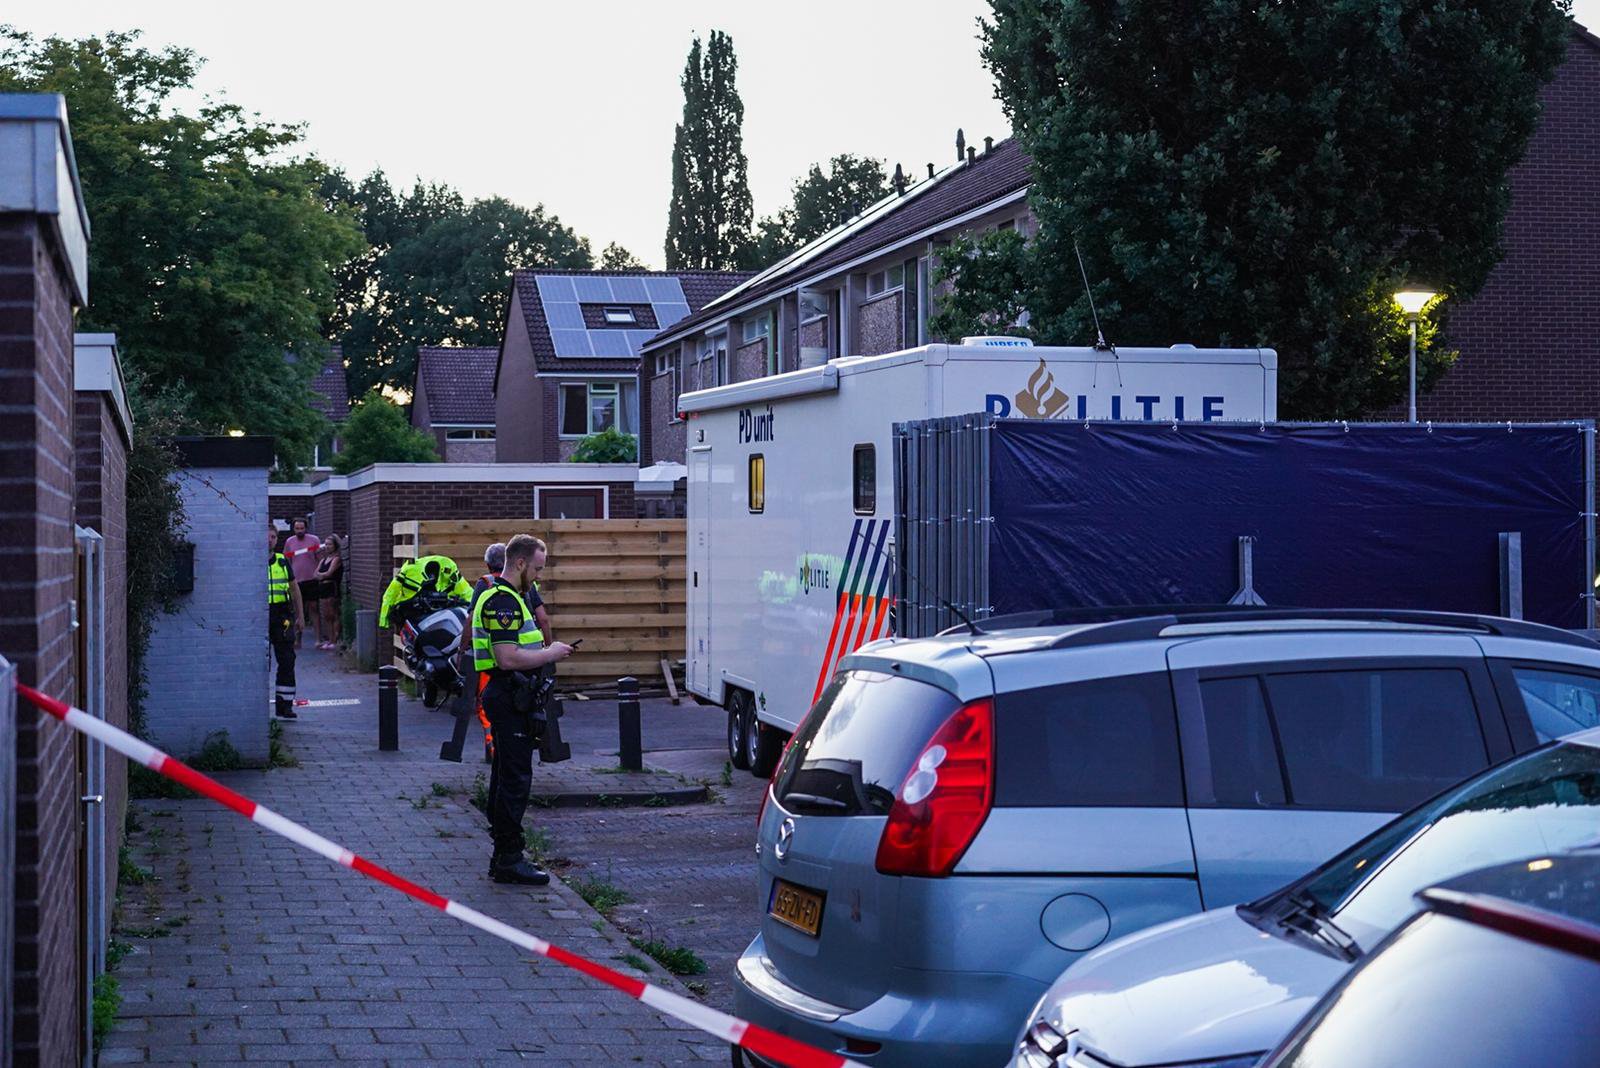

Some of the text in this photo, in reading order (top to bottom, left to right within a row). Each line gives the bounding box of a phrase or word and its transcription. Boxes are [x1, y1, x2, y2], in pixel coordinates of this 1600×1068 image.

[739, 403, 774, 444] PD unit
[985, 394, 1225, 420] PLITIE
